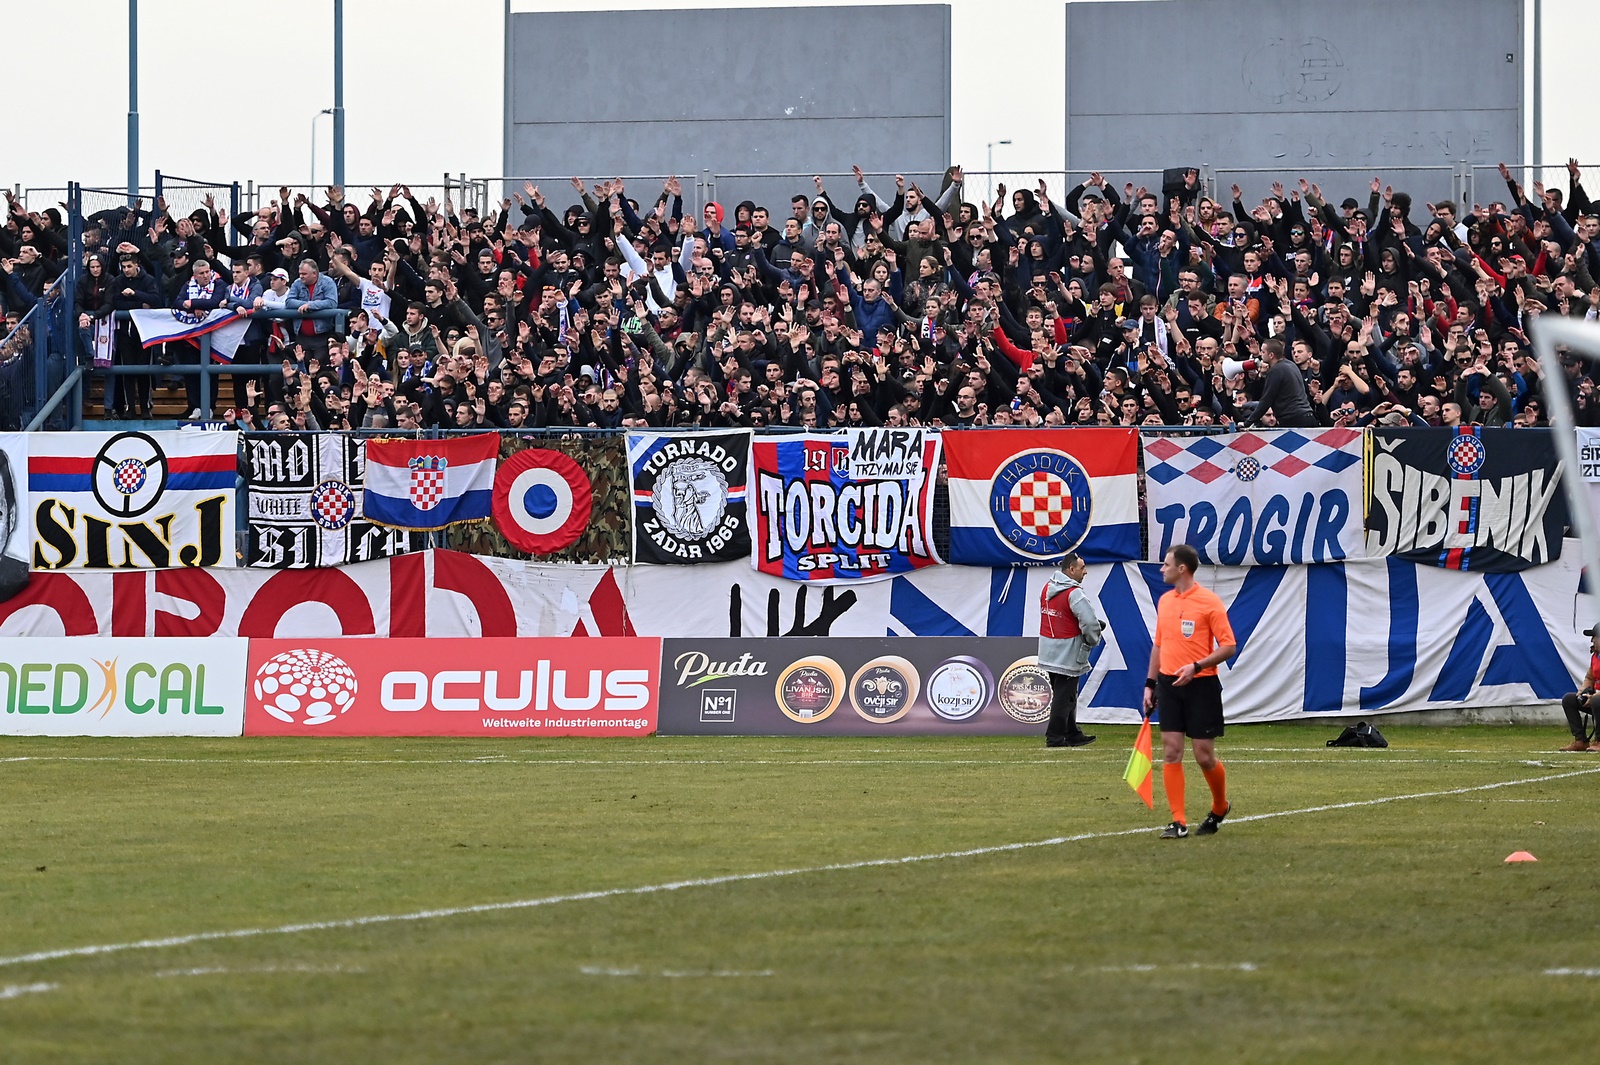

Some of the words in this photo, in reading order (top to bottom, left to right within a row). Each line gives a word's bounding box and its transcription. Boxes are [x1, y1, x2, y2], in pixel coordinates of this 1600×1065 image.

[851, 429, 922, 462] MARA
[1451, 436, 1481, 449] HAJDUK
[117, 459, 145, 470] HAJDUK
[642, 440, 738, 475] TORNADO
[1002, 455, 1080, 484] HAJDUK
[314, 482, 350, 498] HAJDUK
[1366, 436, 1566, 564] ŠIBENIK
[256, 497, 301, 515] WHITE
[758, 467, 929, 563] TORCIDA
[34, 496, 227, 569] SINJ
[318, 517, 347, 529] SPLIT
[1156, 489, 1349, 566] TROGIR
[643, 518, 702, 558] ZADAR
[706, 515, 739, 553] 1965
[1008, 529, 1073, 552] SPLIT
[797, 552, 892, 571] SPLIT
[380, 659, 650, 712] oculus
[785, 685, 830, 694] LIVANJSKI
[863, 694, 885, 708] ovčji
[886, 694, 899, 706] sir
[937, 693, 960, 708] kozji
[961, 694, 974, 706] sir
[482, 717, 541, 728] Weltweite
[544, 717, 648, 729] Industriemontage
